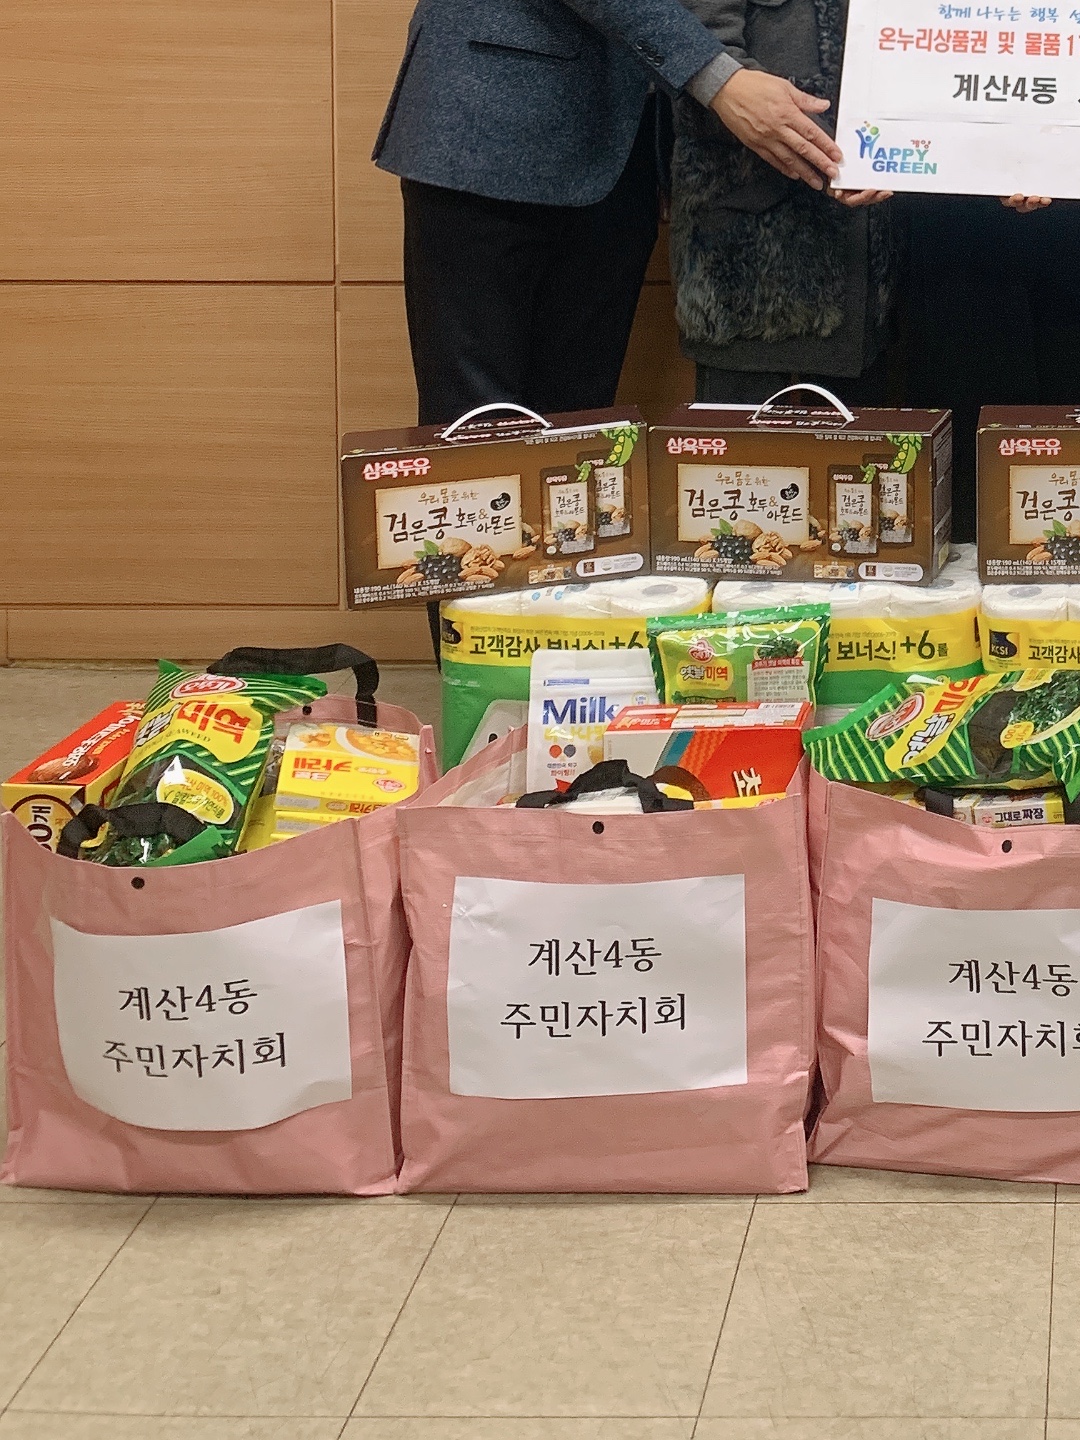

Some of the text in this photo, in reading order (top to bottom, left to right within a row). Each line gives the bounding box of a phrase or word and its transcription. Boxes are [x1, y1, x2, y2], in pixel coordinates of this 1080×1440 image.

[938, 5, 971, 19] 함께
[975, 7, 1018, 20] 나누는
[1029, 8, 1057, 22] 행복
[878, 28, 989, 53] 온누리상품권
[996, 32, 1015, 53] 및
[953, 75, 1057, 104] 계산4동
[872, 160, 937, 174] GREEN
[666, 437, 728, 456] 삼육두유
[998, 438, 1062, 456] 삼육두유
[362, 457, 431, 481] 삼육두유
[715, 472, 734, 486] 우리
[1048, 473, 1068, 486] 우리
[418, 490, 440, 505] 우리
[684, 488, 745, 521] 검은콩
[1016, 488, 1080, 522] 검은콩
[383, 507, 452, 543] 검은콩
[476, 516, 517, 535] 아몬드
[767, 504, 803, 524] 아몬드
[469, 634, 540, 658] 고객감사
[836, 639, 896, 661] 보너스!
[542, 696, 619, 725] Milk
[529, 938, 661, 976] 계산4동
[949, 960, 1078, 996] 계산4동
[119, 980, 257, 1021] 계산4동
[501, 994, 685, 1039] 주민자치회
[103, 1033, 285, 1078] 주민자치회
